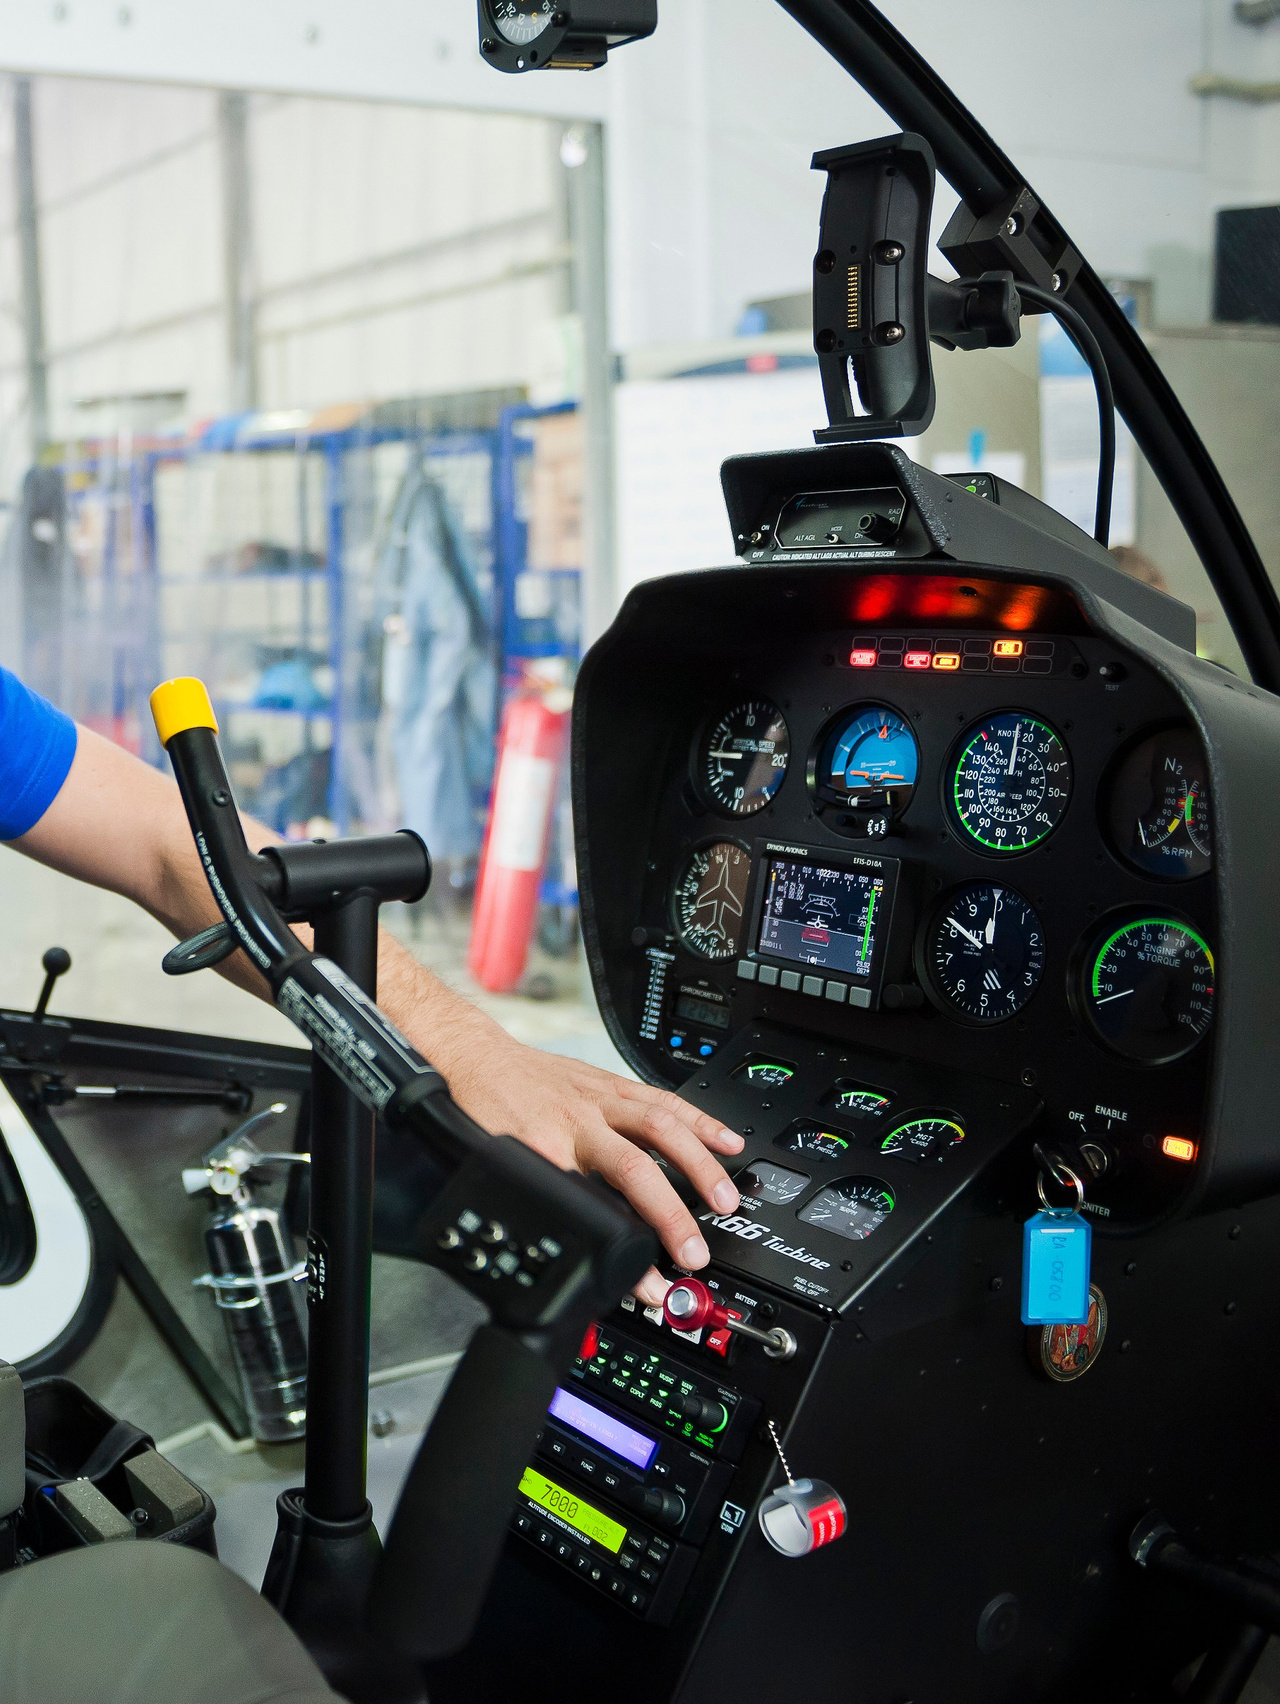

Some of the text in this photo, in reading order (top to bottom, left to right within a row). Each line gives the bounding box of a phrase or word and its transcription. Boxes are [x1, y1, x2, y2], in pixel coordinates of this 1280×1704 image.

[752, 551, 765, 559] OFF
[1022, 733, 1034, 743] 20
[984, 742, 1000, 753] 140
[1037, 742, 1050, 753] 30
[771, 753, 785, 767] 20
[972, 755, 987, 767] 130
[995, 756, 1008, 767] 260
[1016, 755, 1027, 764] 40
[987, 765, 1000, 776] 240
[1002, 768, 1024, 778] K/H
[1028, 763, 1038, 772] 60
[1046, 761, 1060, 773] 40
[965, 770, 979, 782] 120
[983, 776, 996, 785] 220
[1030, 776, 1040, 785] 80
[734, 787, 745, 799] 10
[964, 786, 974, 799] 110
[983, 788, 996, 797] 200
[1025, 789, 1037, 798] 100
[1047, 787, 1060, 800] 50
[987, 797, 999, 806] 180
[1020, 803, 1032, 812] 120
[1164, 798, 1176, 807] 100
[968, 805, 982, 816] 100
[993, 805, 1005, 816] 160
[1005, 808, 1018, 816] 140
[978, 817, 991, 828] 90
[1035, 812, 1048, 824] 60
[995, 828, 1007, 839] 80
[1016, 825, 1028, 836] 70
[196, 831, 211, 858] LOW
[202, 855, 213, 867] G
[968, 903, 979, 917] 9
[1029, 931, 1039, 947] 2
[1127, 938, 1139, 948] 40
[1141, 932, 1152, 942] 50
[1157, 932, 1169, 942] 60
[1175, 937, 1186, 948] 70
[1115, 948, 1127, 958] 30
[1143, 942, 1178, 958] ENGINE
[1184, 948, 1196, 959] 80
[944, 952, 954, 966] 7
[1136, 951, 1181, 969] %TORQUE
[1106, 962, 1118, 974] 20
[1192, 964, 1205, 976] 90
[956, 979, 967, 992] 6
[1023, 972, 1033, 987] 3
[1103, 982, 1114, 993] 10
[1191, 982, 1206, 994] 100
[680, 985, 724, 1003] CHRONOMETER
[979, 993, 990, 1007] 5
[1005, 990, 1016, 1003] 4
[1189, 1000, 1201, 1011] 110
[1177, 1013, 1193, 1025] 120
[1068, 1110, 1085, 1123] OFF
[1094, 1103, 1128, 1122] ENABLE
[915, 1132, 935, 1143] MGT
[763, 1182, 777, 1192] FUEL
[1080, 1200, 1111, 1218] GNITER
[762, 1235, 831, 1270] Turbine
[318, 1253, 326, 1283] LAND
[707, 1279, 720, 1290] GEN
[734, 1291, 759, 1308] BATTERY
[646, 1304, 660, 1316] OFF
[708, 1336, 723, 1348] OFF
[612, 1376, 626, 1389] PILOT
[658, 1373, 676, 1385] MUSIC
[629, 1387, 646, 1400] COPLT
[717, 1387, 738, 1402] GARMIN
[649, 1397, 663, 1409] PASS
[689, 1450, 710, 1466] GARMIN
[580, 1460, 594, 1473] FUNC
[605, 1475, 617, 1487] CLR
[540, 1483, 580, 1519] 7000
[518, 1519, 525, 1527] 4
[528, 1501, 592, 1546] ALTITUDE ENCODER INSTALLED
[540, 1533, 547, 1543] 5
[559, 1546, 566, 1556] 6
[578, 1559, 585, 1568] 7
[640, 1570, 651, 1580] CLR
[611, 1581, 618, 1591] 8
[631, 1594, 638, 1604] 9
